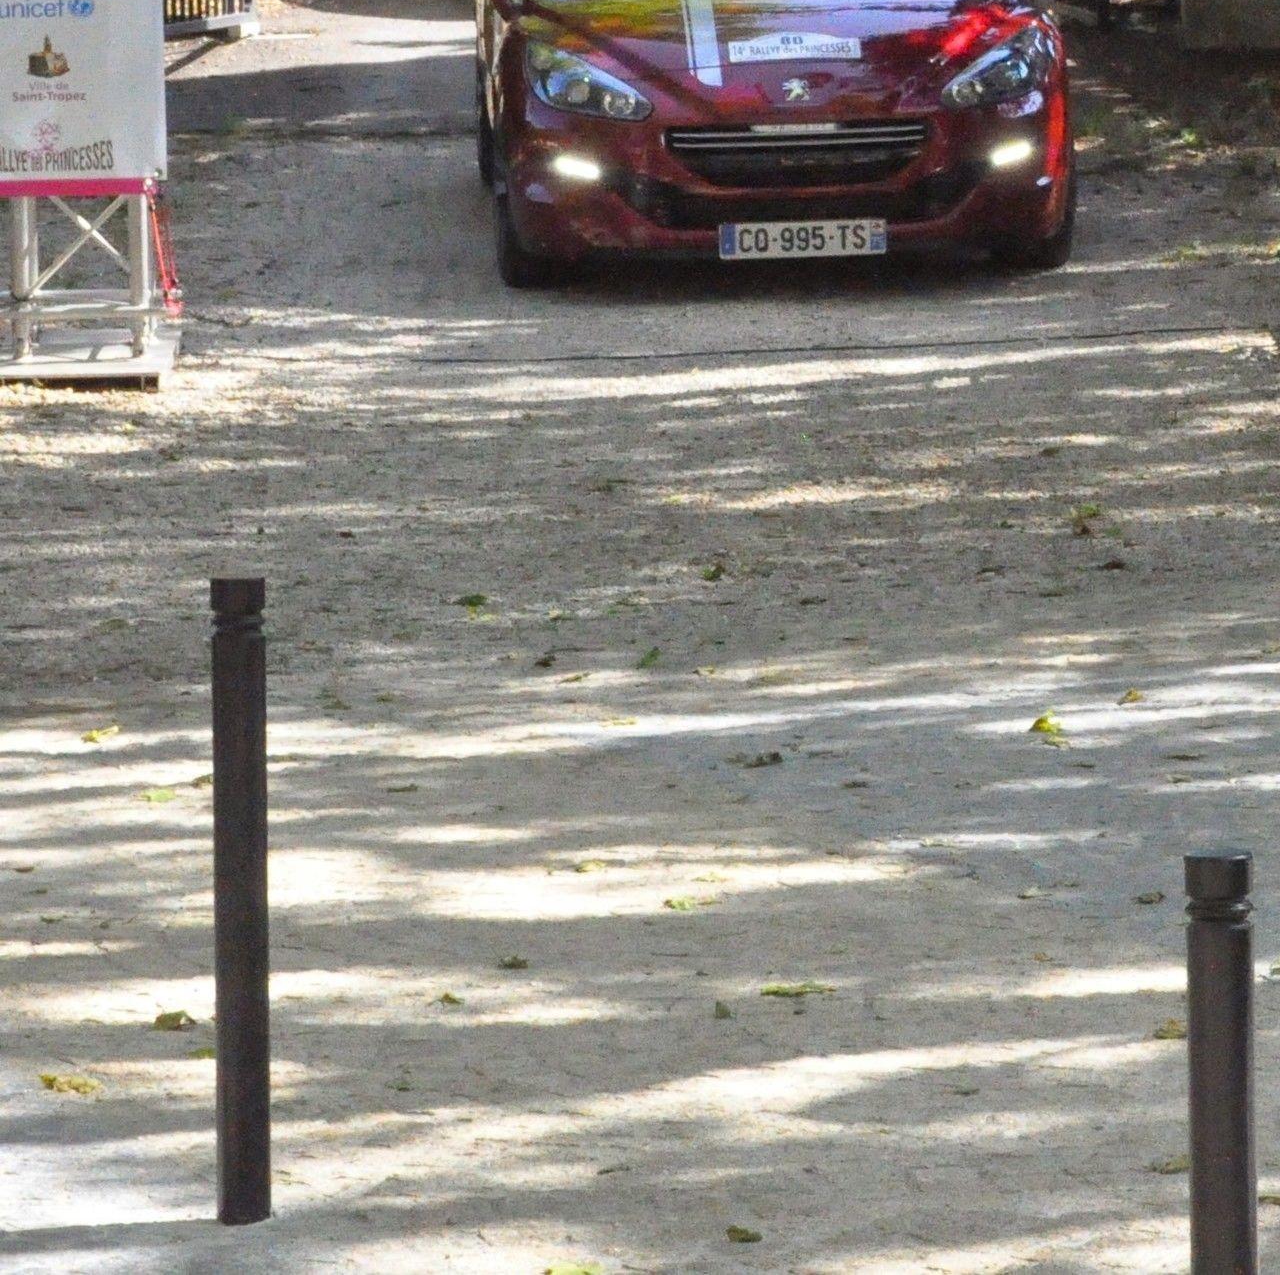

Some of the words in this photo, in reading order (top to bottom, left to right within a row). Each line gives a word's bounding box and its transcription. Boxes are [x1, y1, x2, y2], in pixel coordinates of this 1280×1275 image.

[28, 82, 53, 91] Ville
[55, 82, 69, 91] de
[11, 91, 87, 103] Saint-Tropez
[44, 139, 114, 172] PRINCESSES
